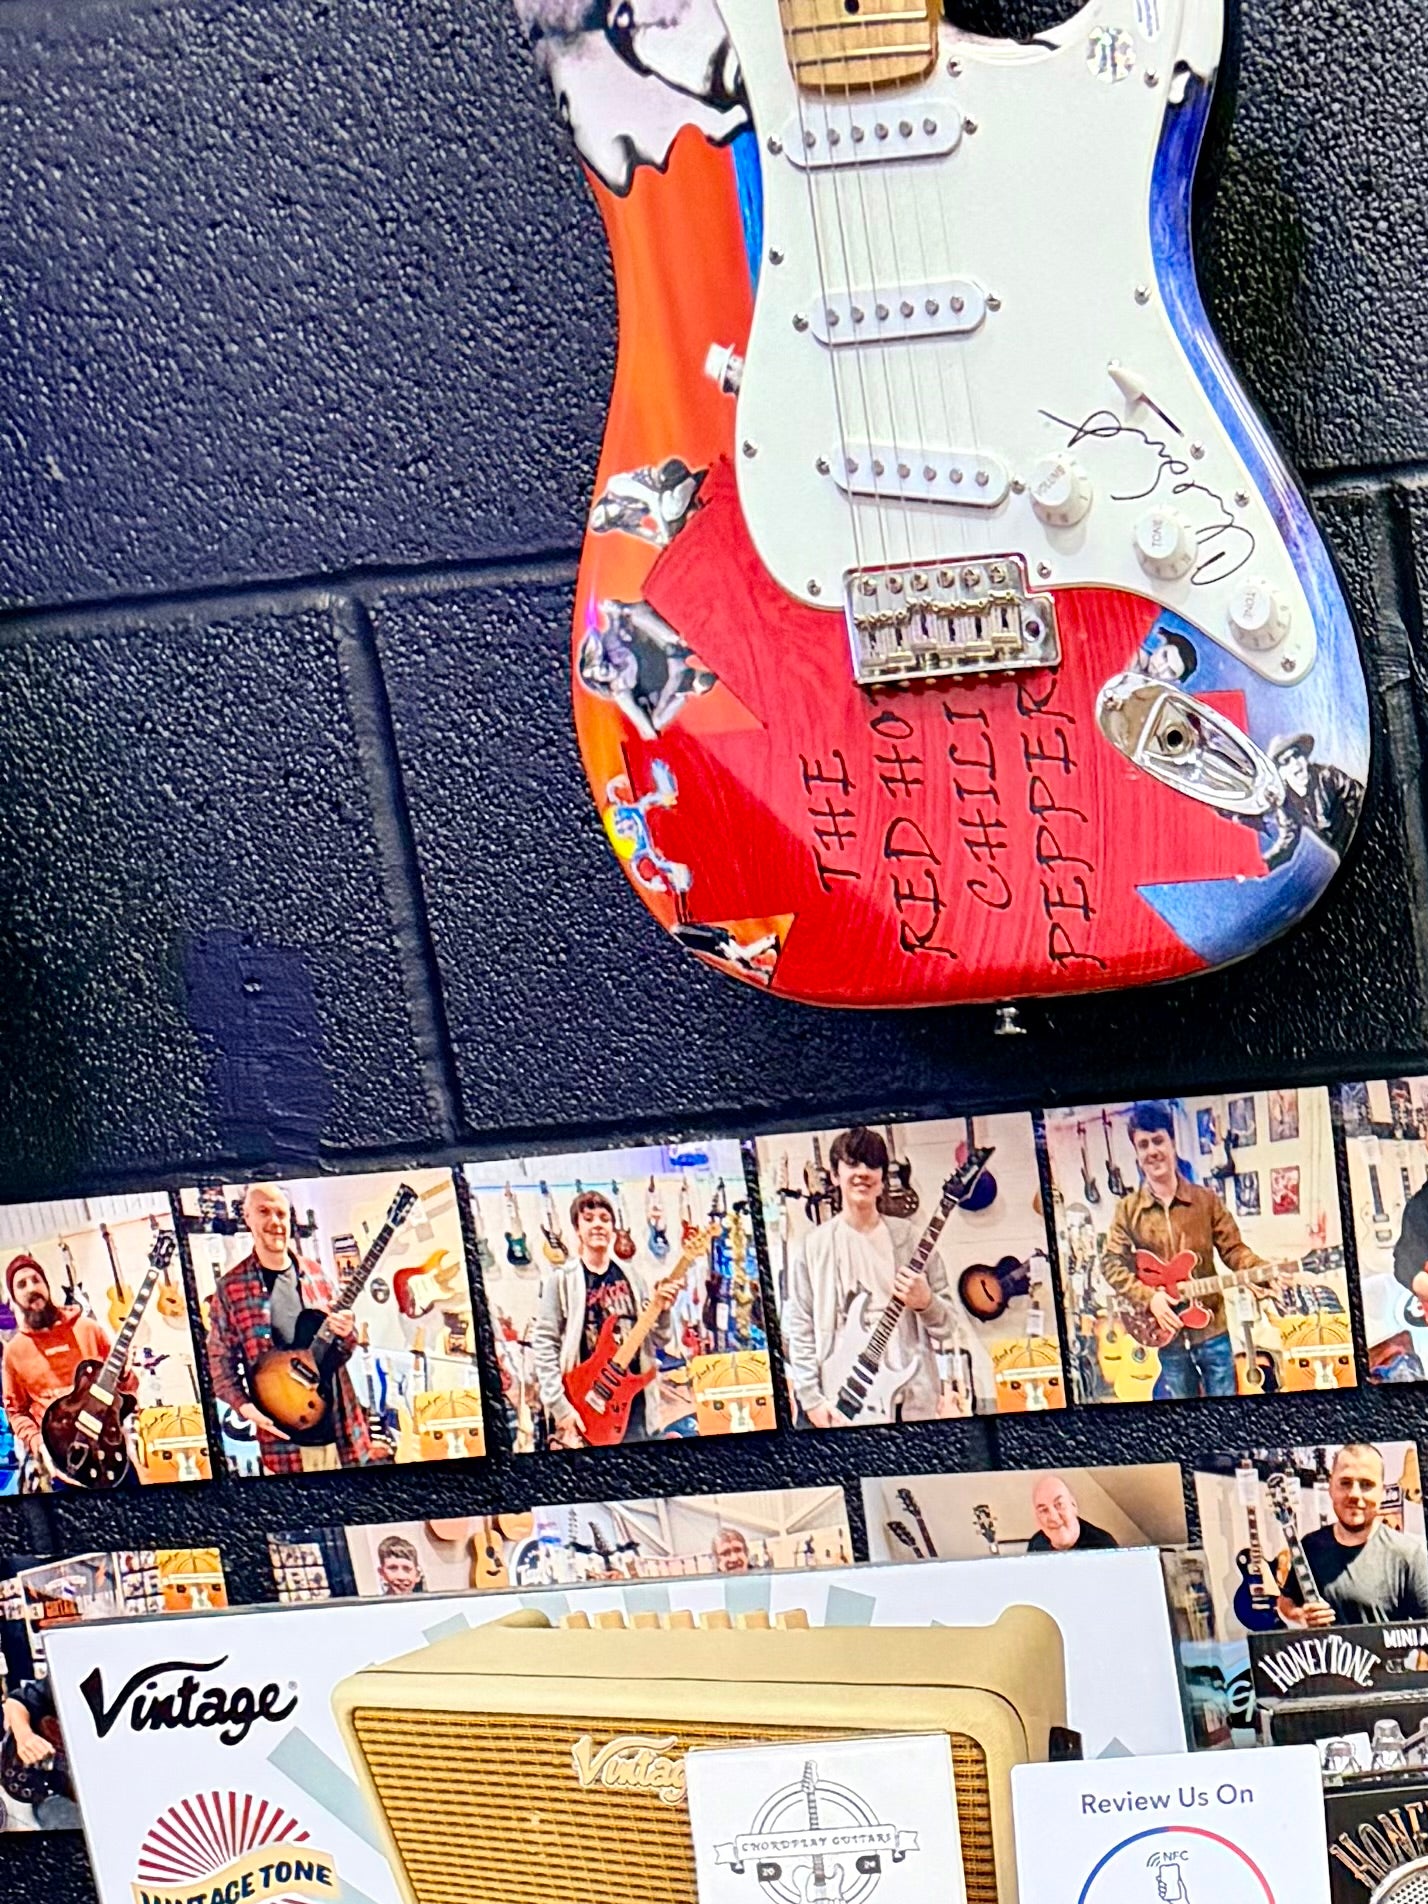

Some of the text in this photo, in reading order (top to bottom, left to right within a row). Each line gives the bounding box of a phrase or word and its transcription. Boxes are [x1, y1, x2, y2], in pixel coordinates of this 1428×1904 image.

[799, 748, 863, 892] THE
[942, 701, 1013, 911] CHILI
[1016, 668, 1107, 971] PEPPER
[883, 816, 958, 961] RED
[79, 1653, 299, 1746] Vintage
[1257, 1634, 1382, 1694] HONEYTONE
[1383, 1629, 1418, 1649] MINI
[571, 1735, 687, 1806] Vintag
[1079, 1783, 1256, 1817] Review Us On
[259, 1859, 334, 1892] TONE
[1162, 1849, 1190, 1863] NFC
